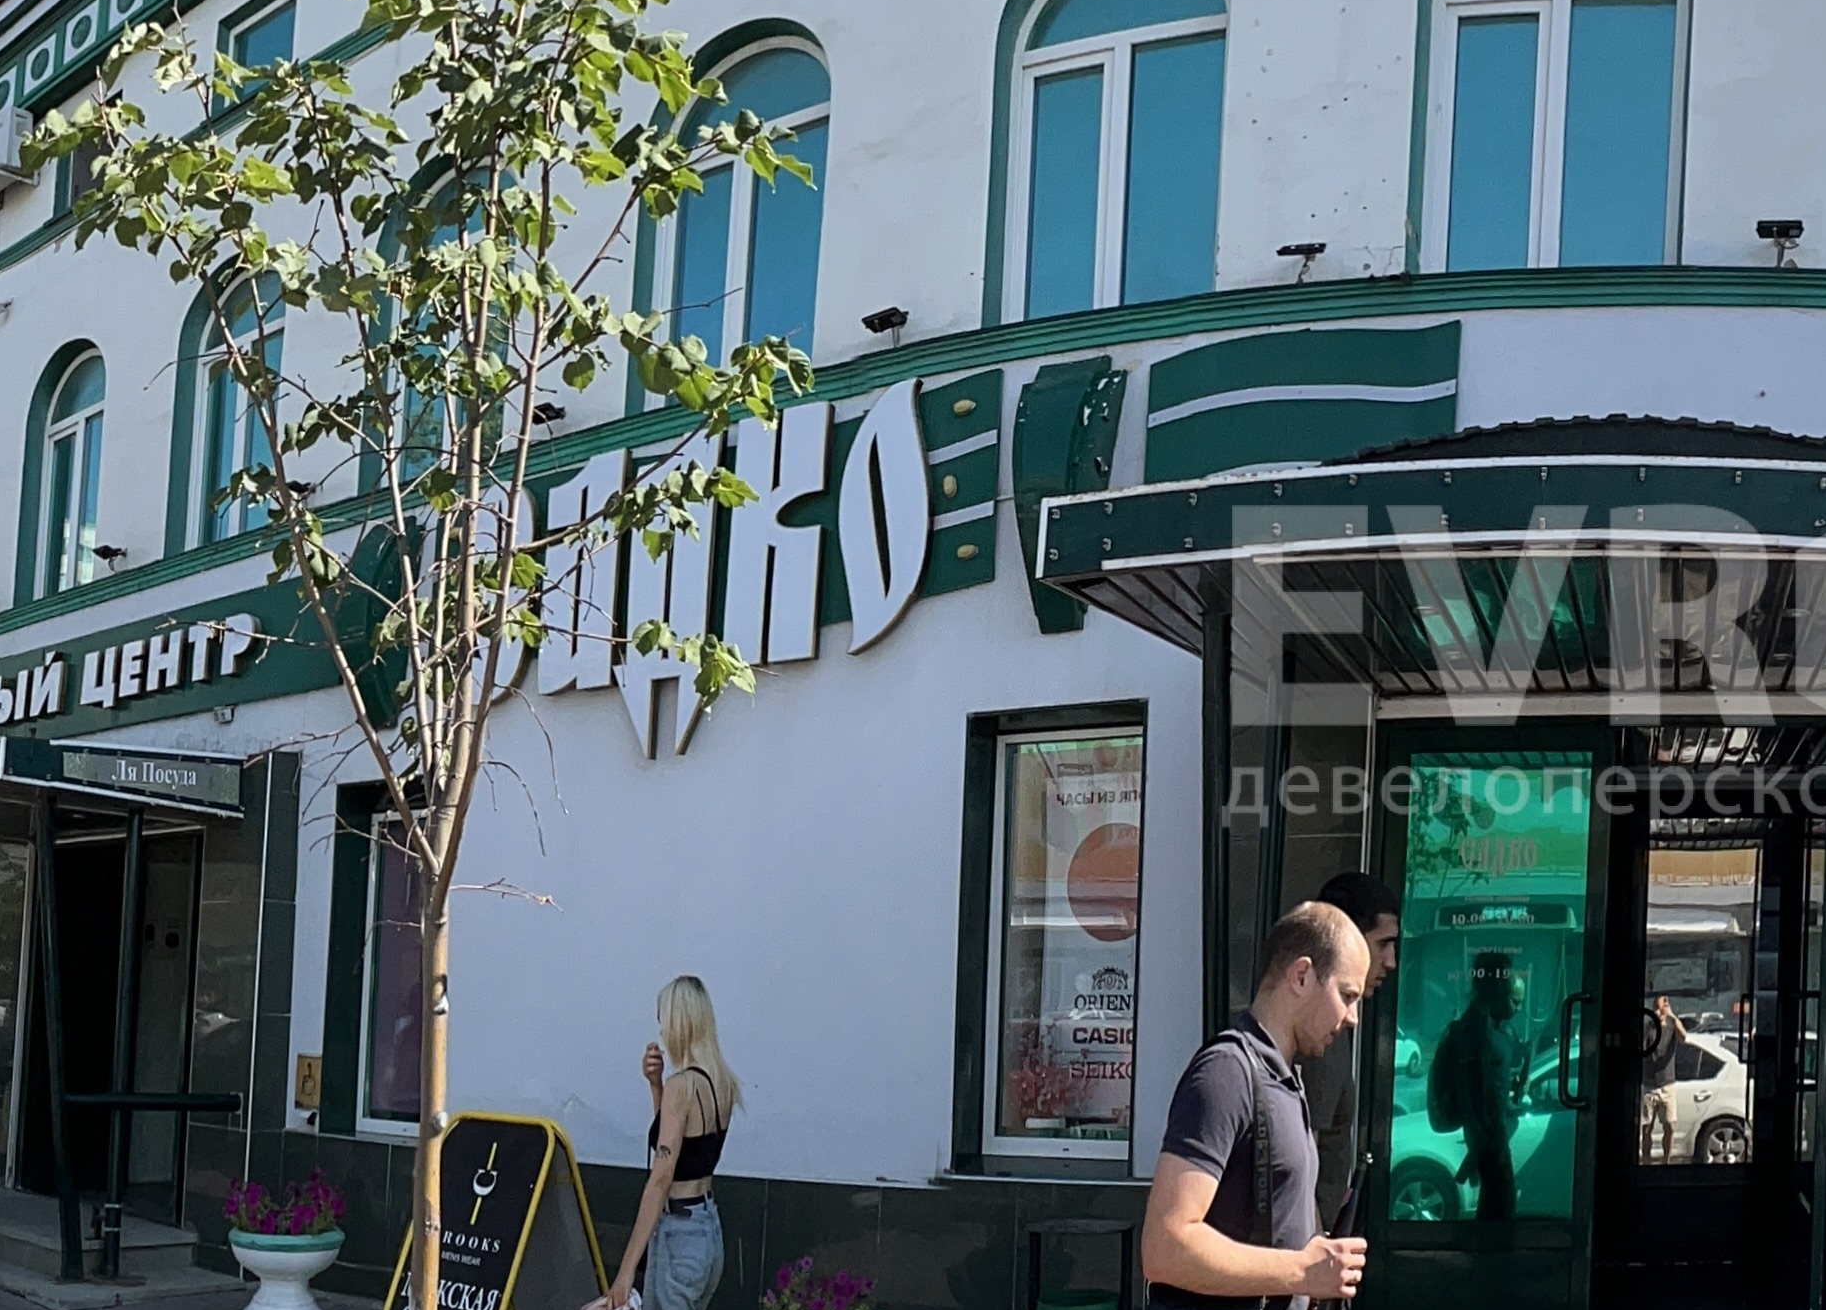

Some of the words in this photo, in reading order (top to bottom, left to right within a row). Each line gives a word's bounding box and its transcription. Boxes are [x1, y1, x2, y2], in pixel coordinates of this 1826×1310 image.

[79, 612, 263, 709] ЦЕНТР
[111, 758, 138, 783] Ля
[141, 760, 198, 790] Посуда
[1056, 791, 1094, 806] ЧАСЫ
[1097, 791, 1116, 804] ИЗ
[1118, 789, 1141, 804] ЯП
[1074, 994, 1133, 1011] ORIEN
[442, 1230, 501, 1253] ROOKS
